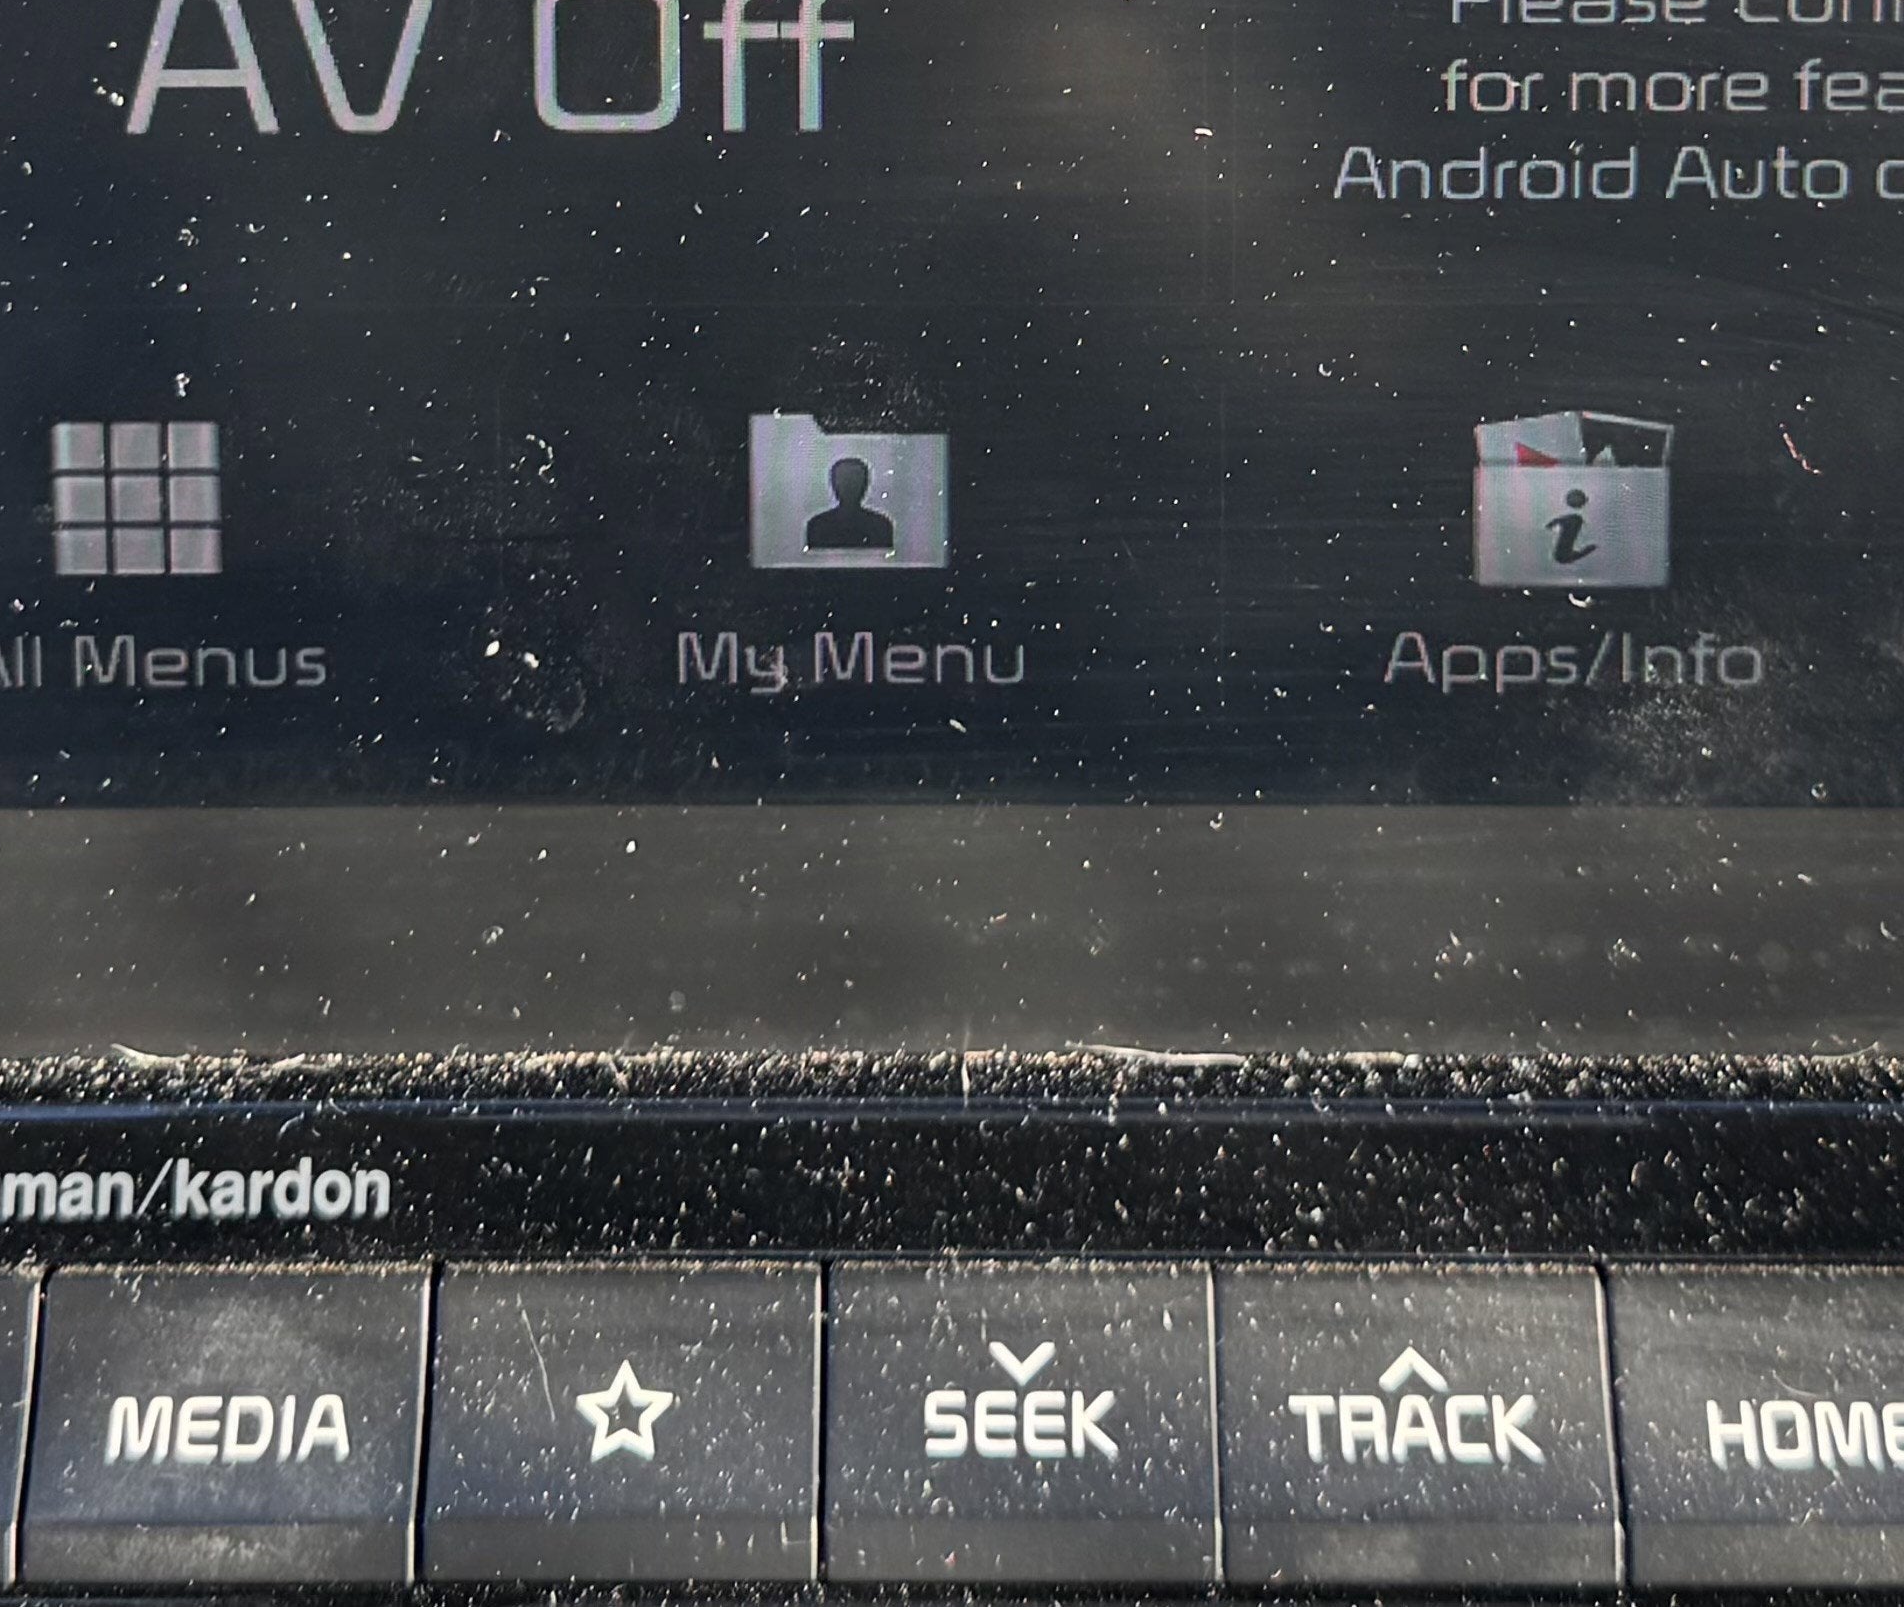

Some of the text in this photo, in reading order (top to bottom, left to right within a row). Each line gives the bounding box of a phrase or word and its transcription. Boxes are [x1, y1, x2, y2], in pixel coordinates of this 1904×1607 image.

[1442, 56, 1538, 116] for
[1570, 68, 1768, 116] more
[1332, 144, 1640, 204] Android
[1665, 146, 1852, 204] Auto
[72, 636, 328, 690] Menus
[676, 632, 1028, 696] My Menu
[1382, 630, 1764, 694] Apps/Info
[106, 1396, 354, 1468] MEDIA
[922, 1390, 1120, 1462] SEEK
[1288, 1396, 1544, 1468] TRACK
